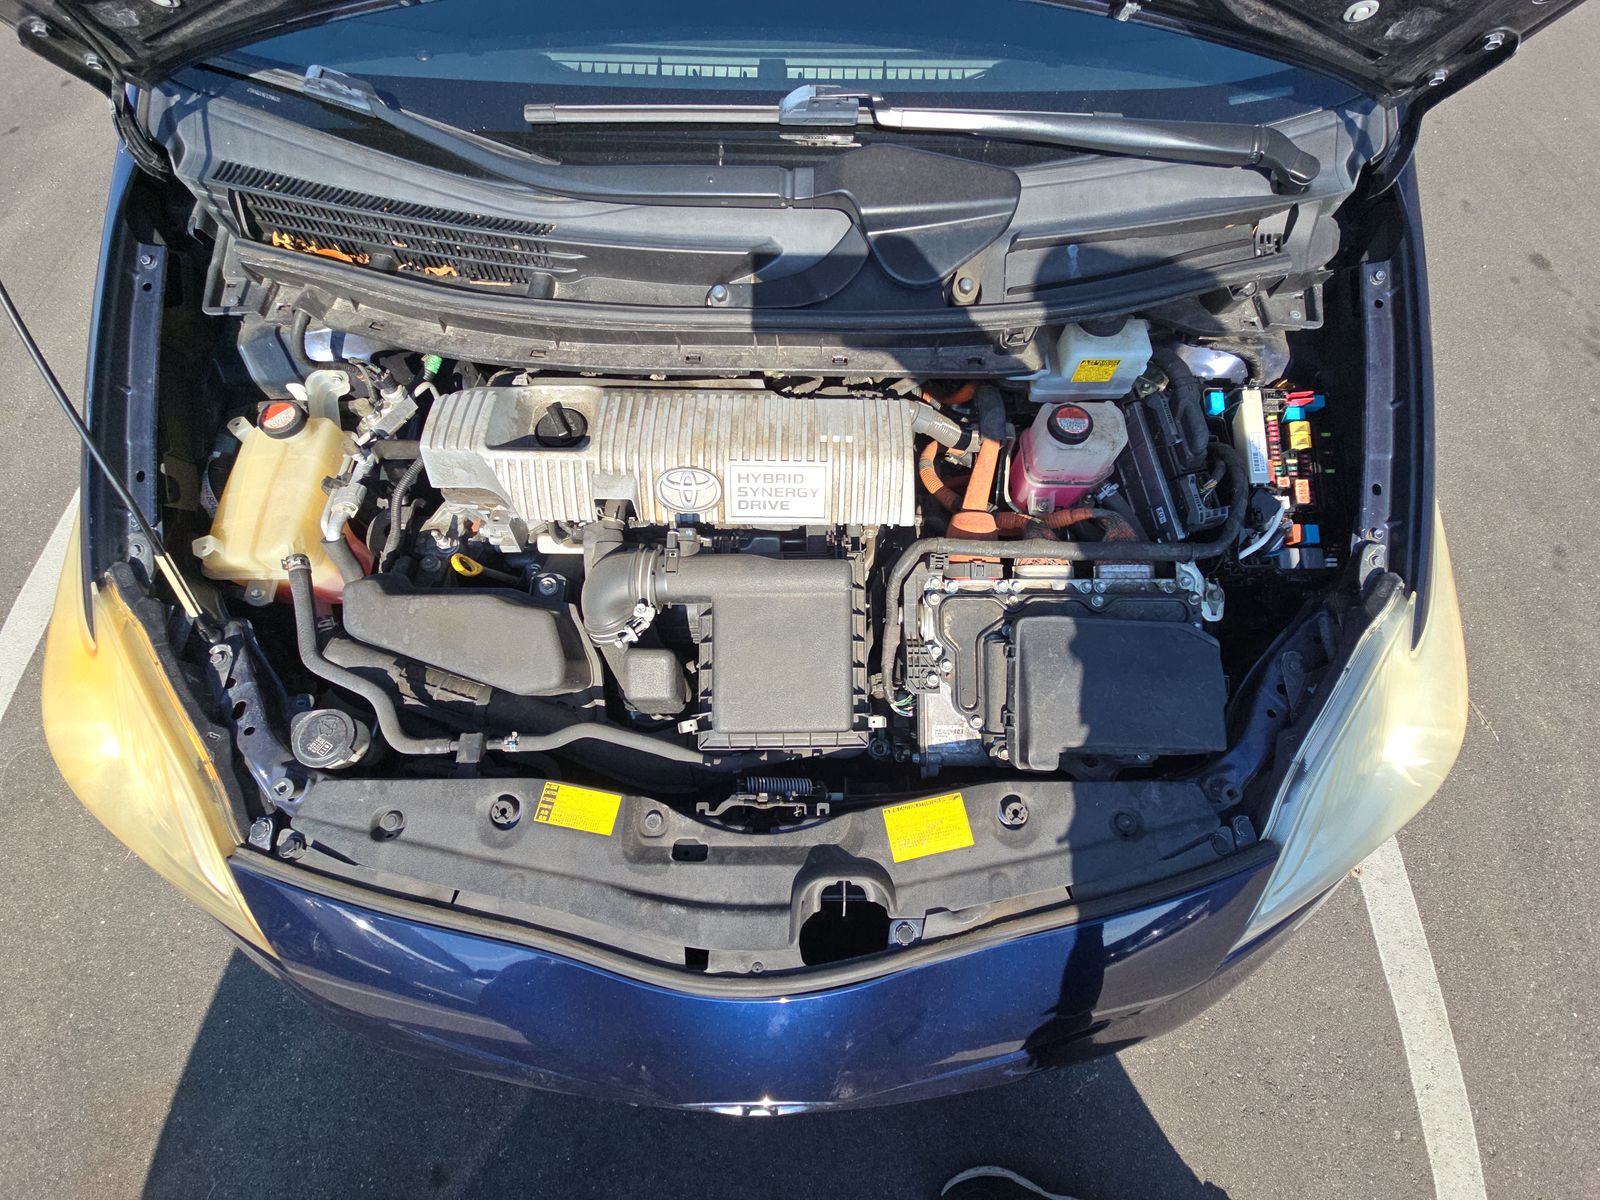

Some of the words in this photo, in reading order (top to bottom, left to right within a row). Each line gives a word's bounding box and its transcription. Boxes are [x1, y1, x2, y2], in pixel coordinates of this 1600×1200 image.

[737, 473, 804, 484] HYBRID
[737, 486, 819, 498] SYNERGY
[738, 500, 791, 510] DRIVE
